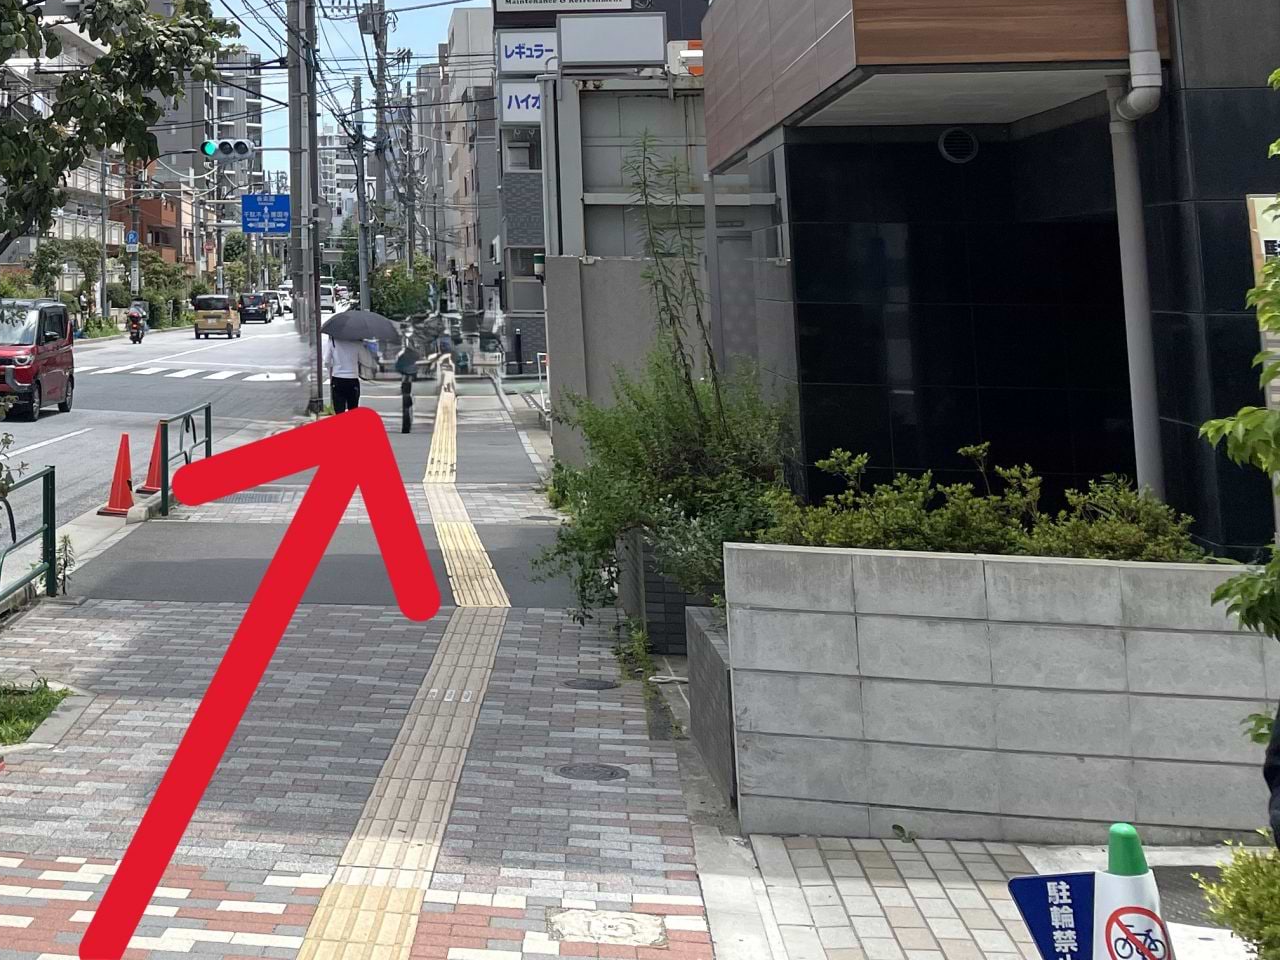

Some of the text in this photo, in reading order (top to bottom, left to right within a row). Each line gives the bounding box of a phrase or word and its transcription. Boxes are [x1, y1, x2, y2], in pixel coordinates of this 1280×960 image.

[504, 43, 554, 59] レギュラー
[1046, 881, 1079, 960] 駐輪禁
